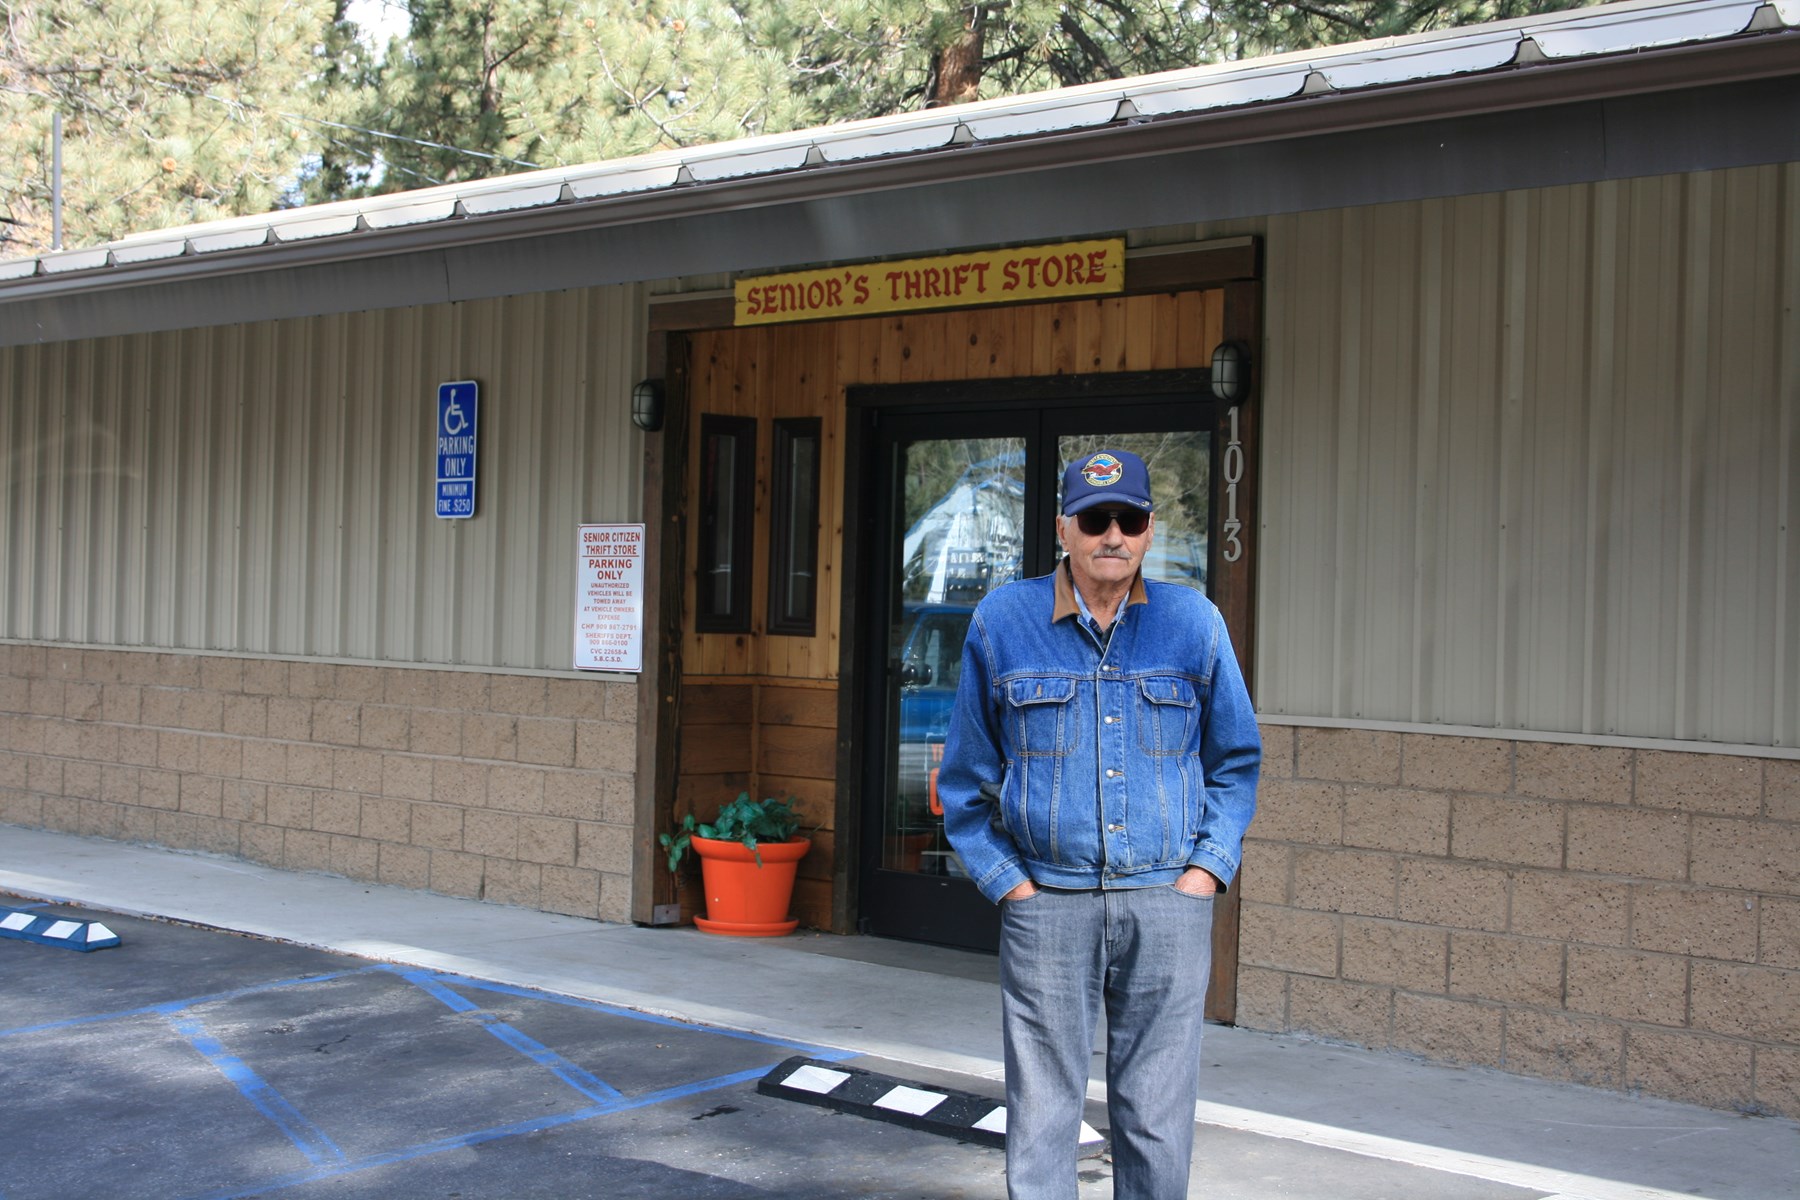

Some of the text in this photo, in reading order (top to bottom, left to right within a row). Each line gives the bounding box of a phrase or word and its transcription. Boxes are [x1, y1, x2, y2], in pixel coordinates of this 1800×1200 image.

[745, 249, 1108, 316] SENIOR'S THRIFT STORE
[439, 436, 473, 455] PARKING
[445, 457, 467, 477] ONLY
[443, 484, 467, 496] MINIMUM
[1223, 406, 1244, 562] 1013
[438, 498, 471, 512] FINE $250
[583, 532, 641, 543] SENIOR CITIZEN
[586, 545, 637, 555] THRIFT STORE
[589, 559, 633, 569] PARKING
[597, 570, 623, 580] ONLY
